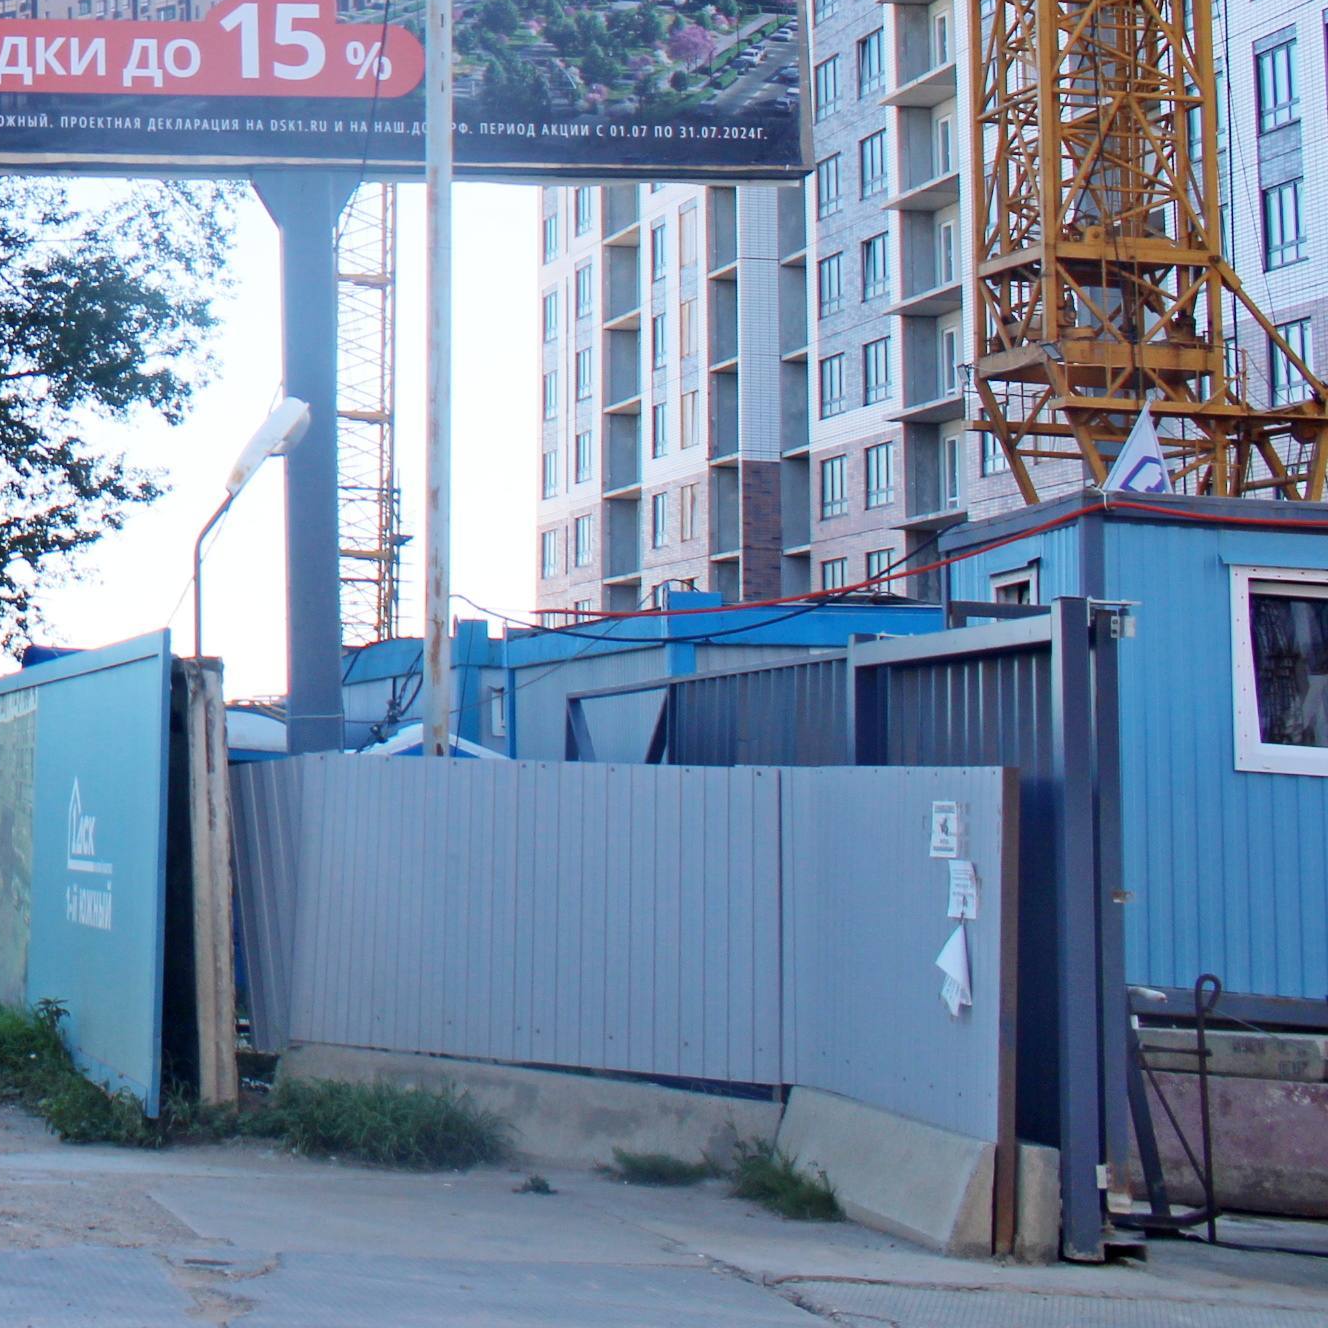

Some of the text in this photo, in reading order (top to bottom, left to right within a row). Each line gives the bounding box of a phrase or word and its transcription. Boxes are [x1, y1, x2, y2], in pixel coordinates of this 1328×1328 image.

[122, 38, 202, 87] ДО
[218, 2, 327, 82] 15
[345, 40, 392, 81] %
[60, 115, 141, 130] ПРОЕКТНАЯ
[147, 117, 240, 133] ДЕКЛАРАЦИЯ
[246, 119, 264, 131] НА
[270, 119, 327, 133] DSK1.RU
[334, 120, 343, 133] И
[350, 121, 368, 133] НА
[479, 122, 536, 139] ПЕРИОД
[541, 123, 590, 139] АКЦИИ
[595, 124, 604, 137] С
[609, 124, 648, 138] 01.07
[654, 125, 673, 139] ПО
[679, 125, 768, 140] 31.07.2024Г.
